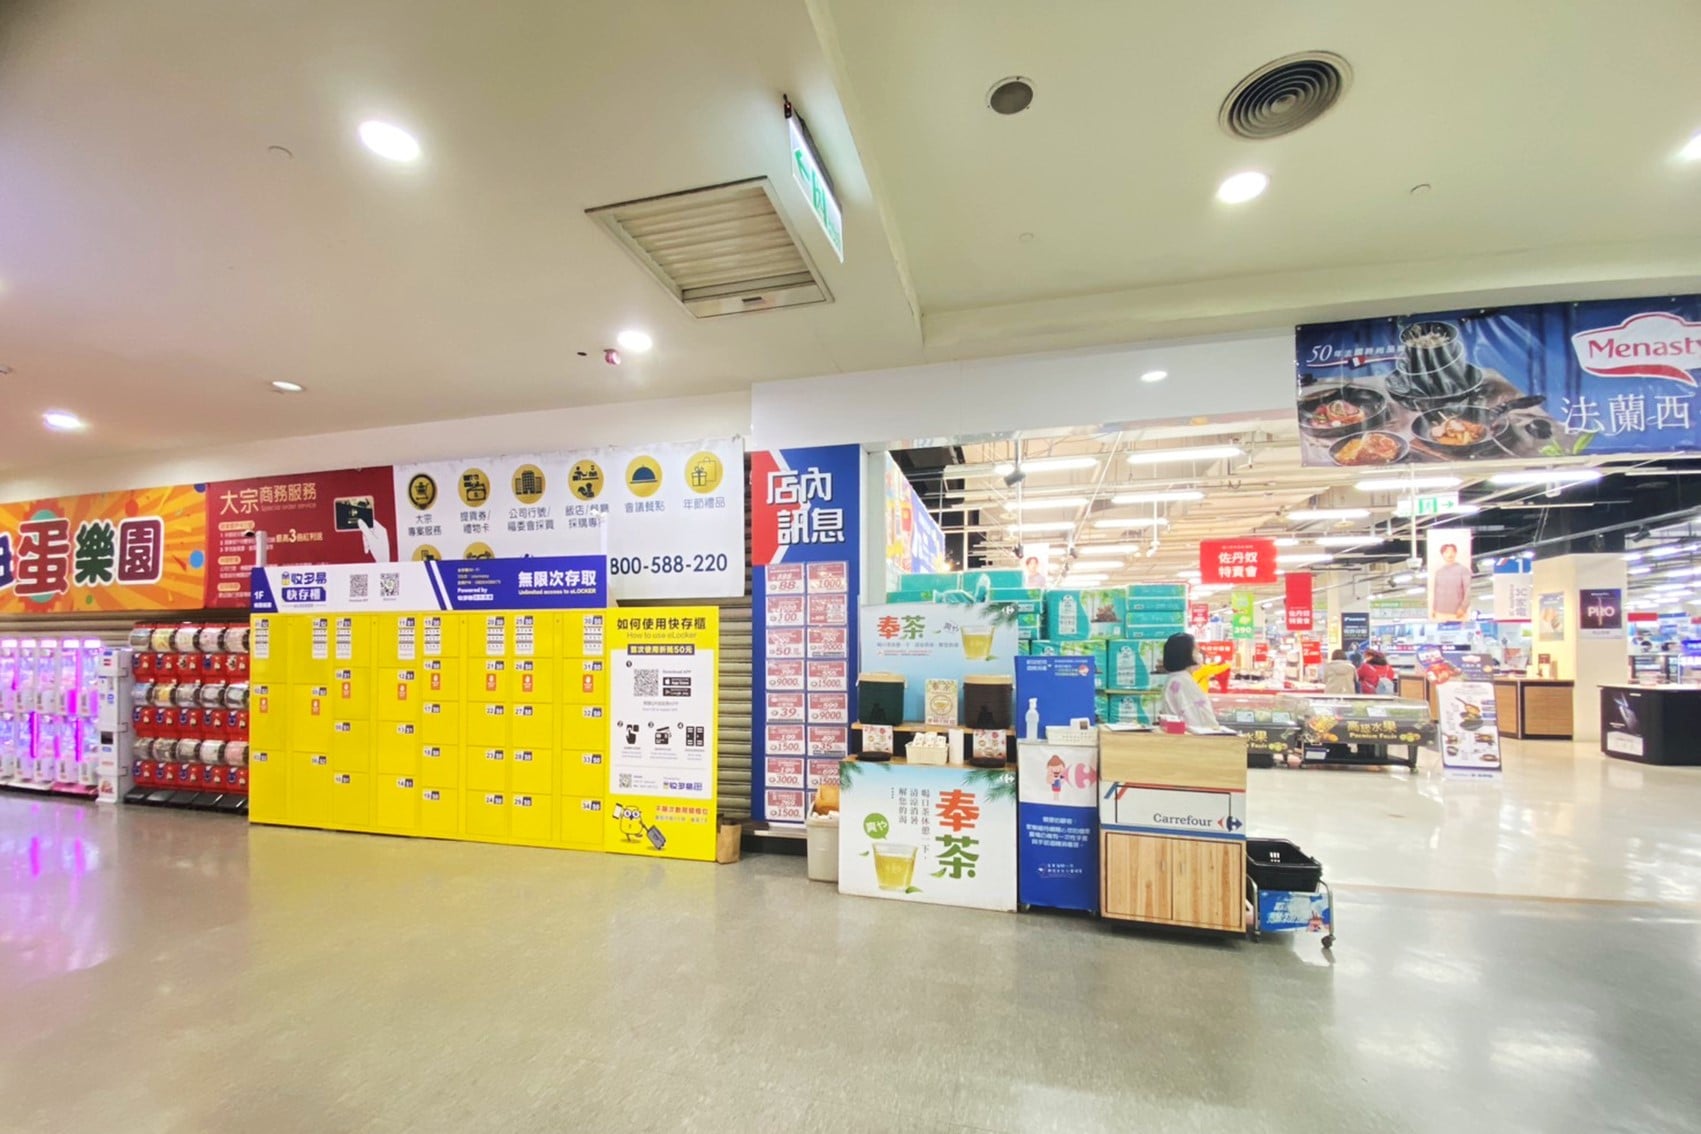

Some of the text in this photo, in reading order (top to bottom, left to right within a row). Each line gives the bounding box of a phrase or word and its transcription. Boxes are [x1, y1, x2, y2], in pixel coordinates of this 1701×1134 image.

[1561, 394, 1690, 435] 法蘭西
[767, 467, 832, 504] 店內
[220, 482, 317, 515] 大宗商務服務
[683, 496, 726, 510] 年節禮品
[415, 515, 432, 525] 大宗
[777, 508, 844, 545] 訊息
[1218, 551, 1258, 564] 佐丹奴
[518, 570, 597, 588] 無限次存取
[1218, 565, 1257, 578] 特賣會
[254, 590, 264, 600] 1F
[616, 617, 706, 630] 如何使用快存櫃
[877, 614, 925, 640] 奉茶
[1153, 813, 1213, 828] Carrefour
[935, 789, 980, 879] 奉茶
